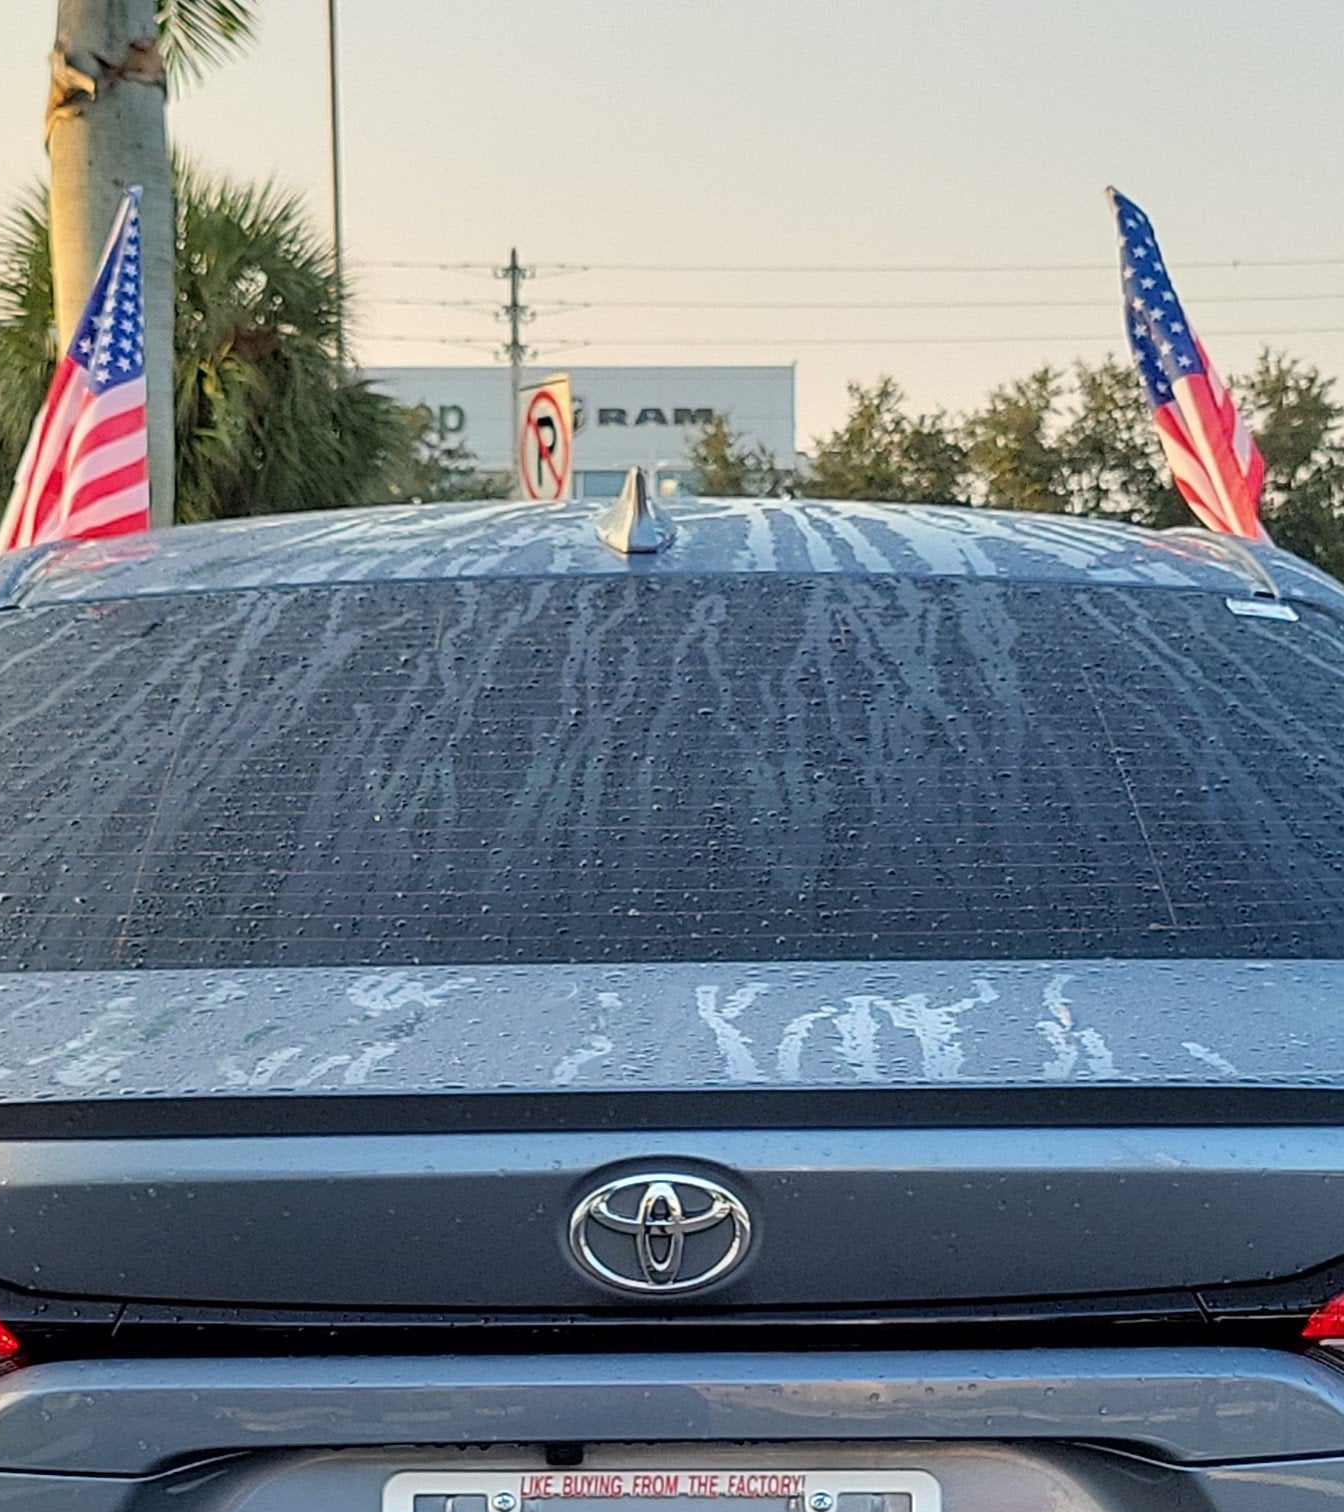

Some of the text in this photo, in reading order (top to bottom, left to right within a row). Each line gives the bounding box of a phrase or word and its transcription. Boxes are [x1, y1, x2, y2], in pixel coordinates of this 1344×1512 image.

[598, 408, 713, 426] RAM
[520, 1474, 806, 1497] LIKE BUYING FROM THE FACTORY!
